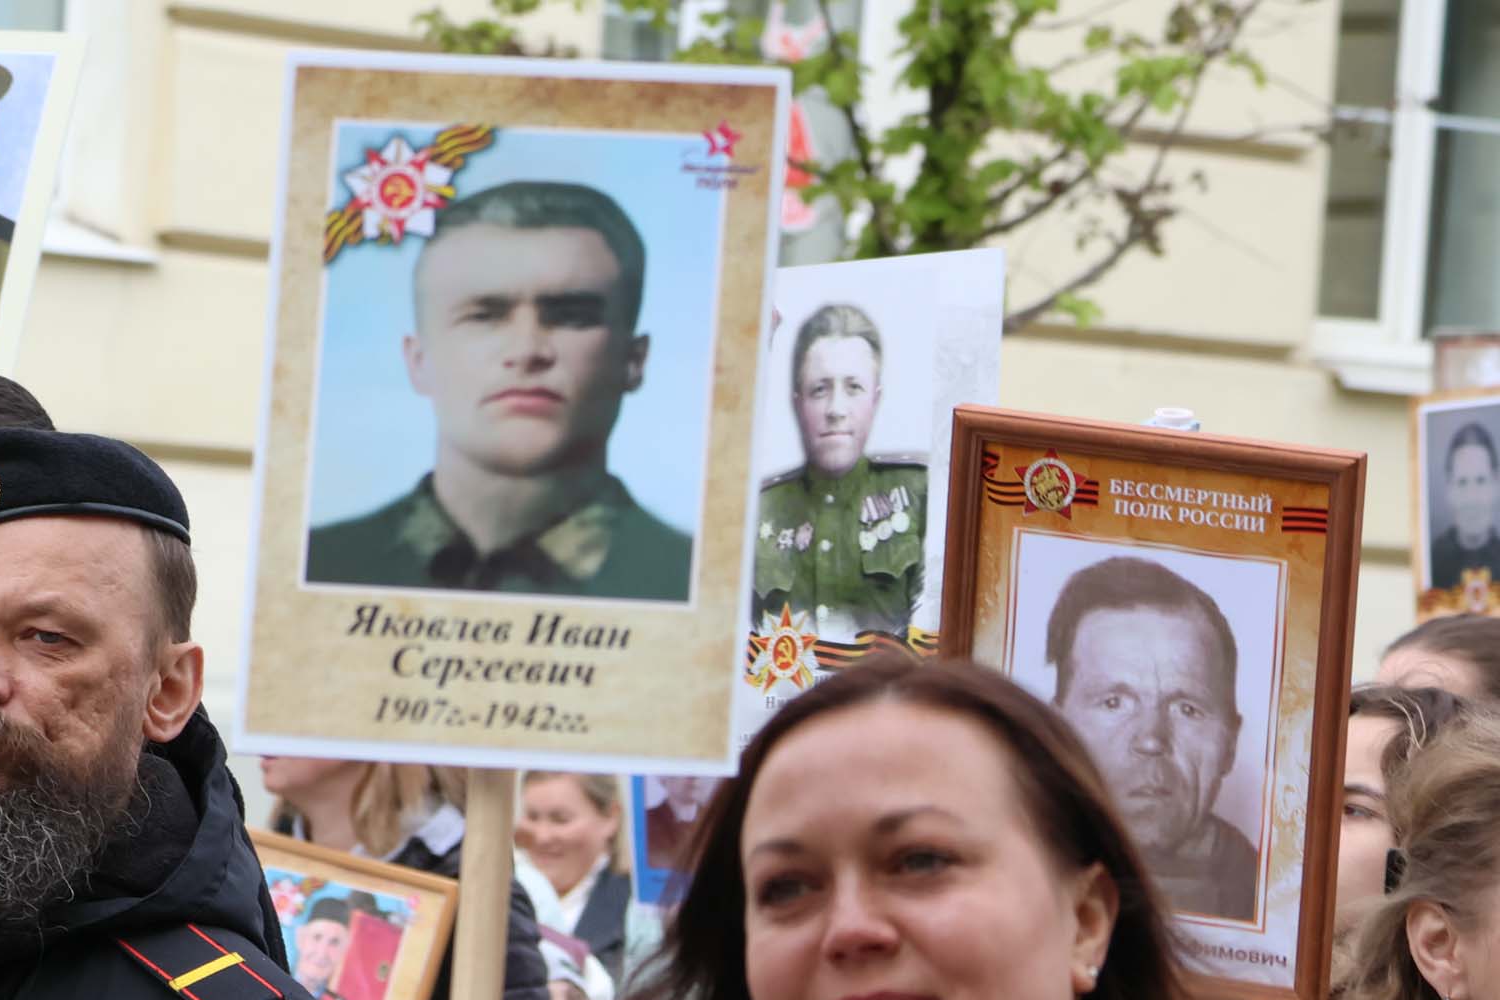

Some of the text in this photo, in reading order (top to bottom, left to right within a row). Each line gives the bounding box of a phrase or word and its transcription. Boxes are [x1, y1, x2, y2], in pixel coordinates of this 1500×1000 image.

[1109, 478, 1273, 514] БЕССМЕРТНЫЙ
[1114, 499, 1266, 533] ПОЛК РОССИИ
[347, 605, 631, 650] Яковлев Иван
[391, 645, 596, 689] Сергеевич
